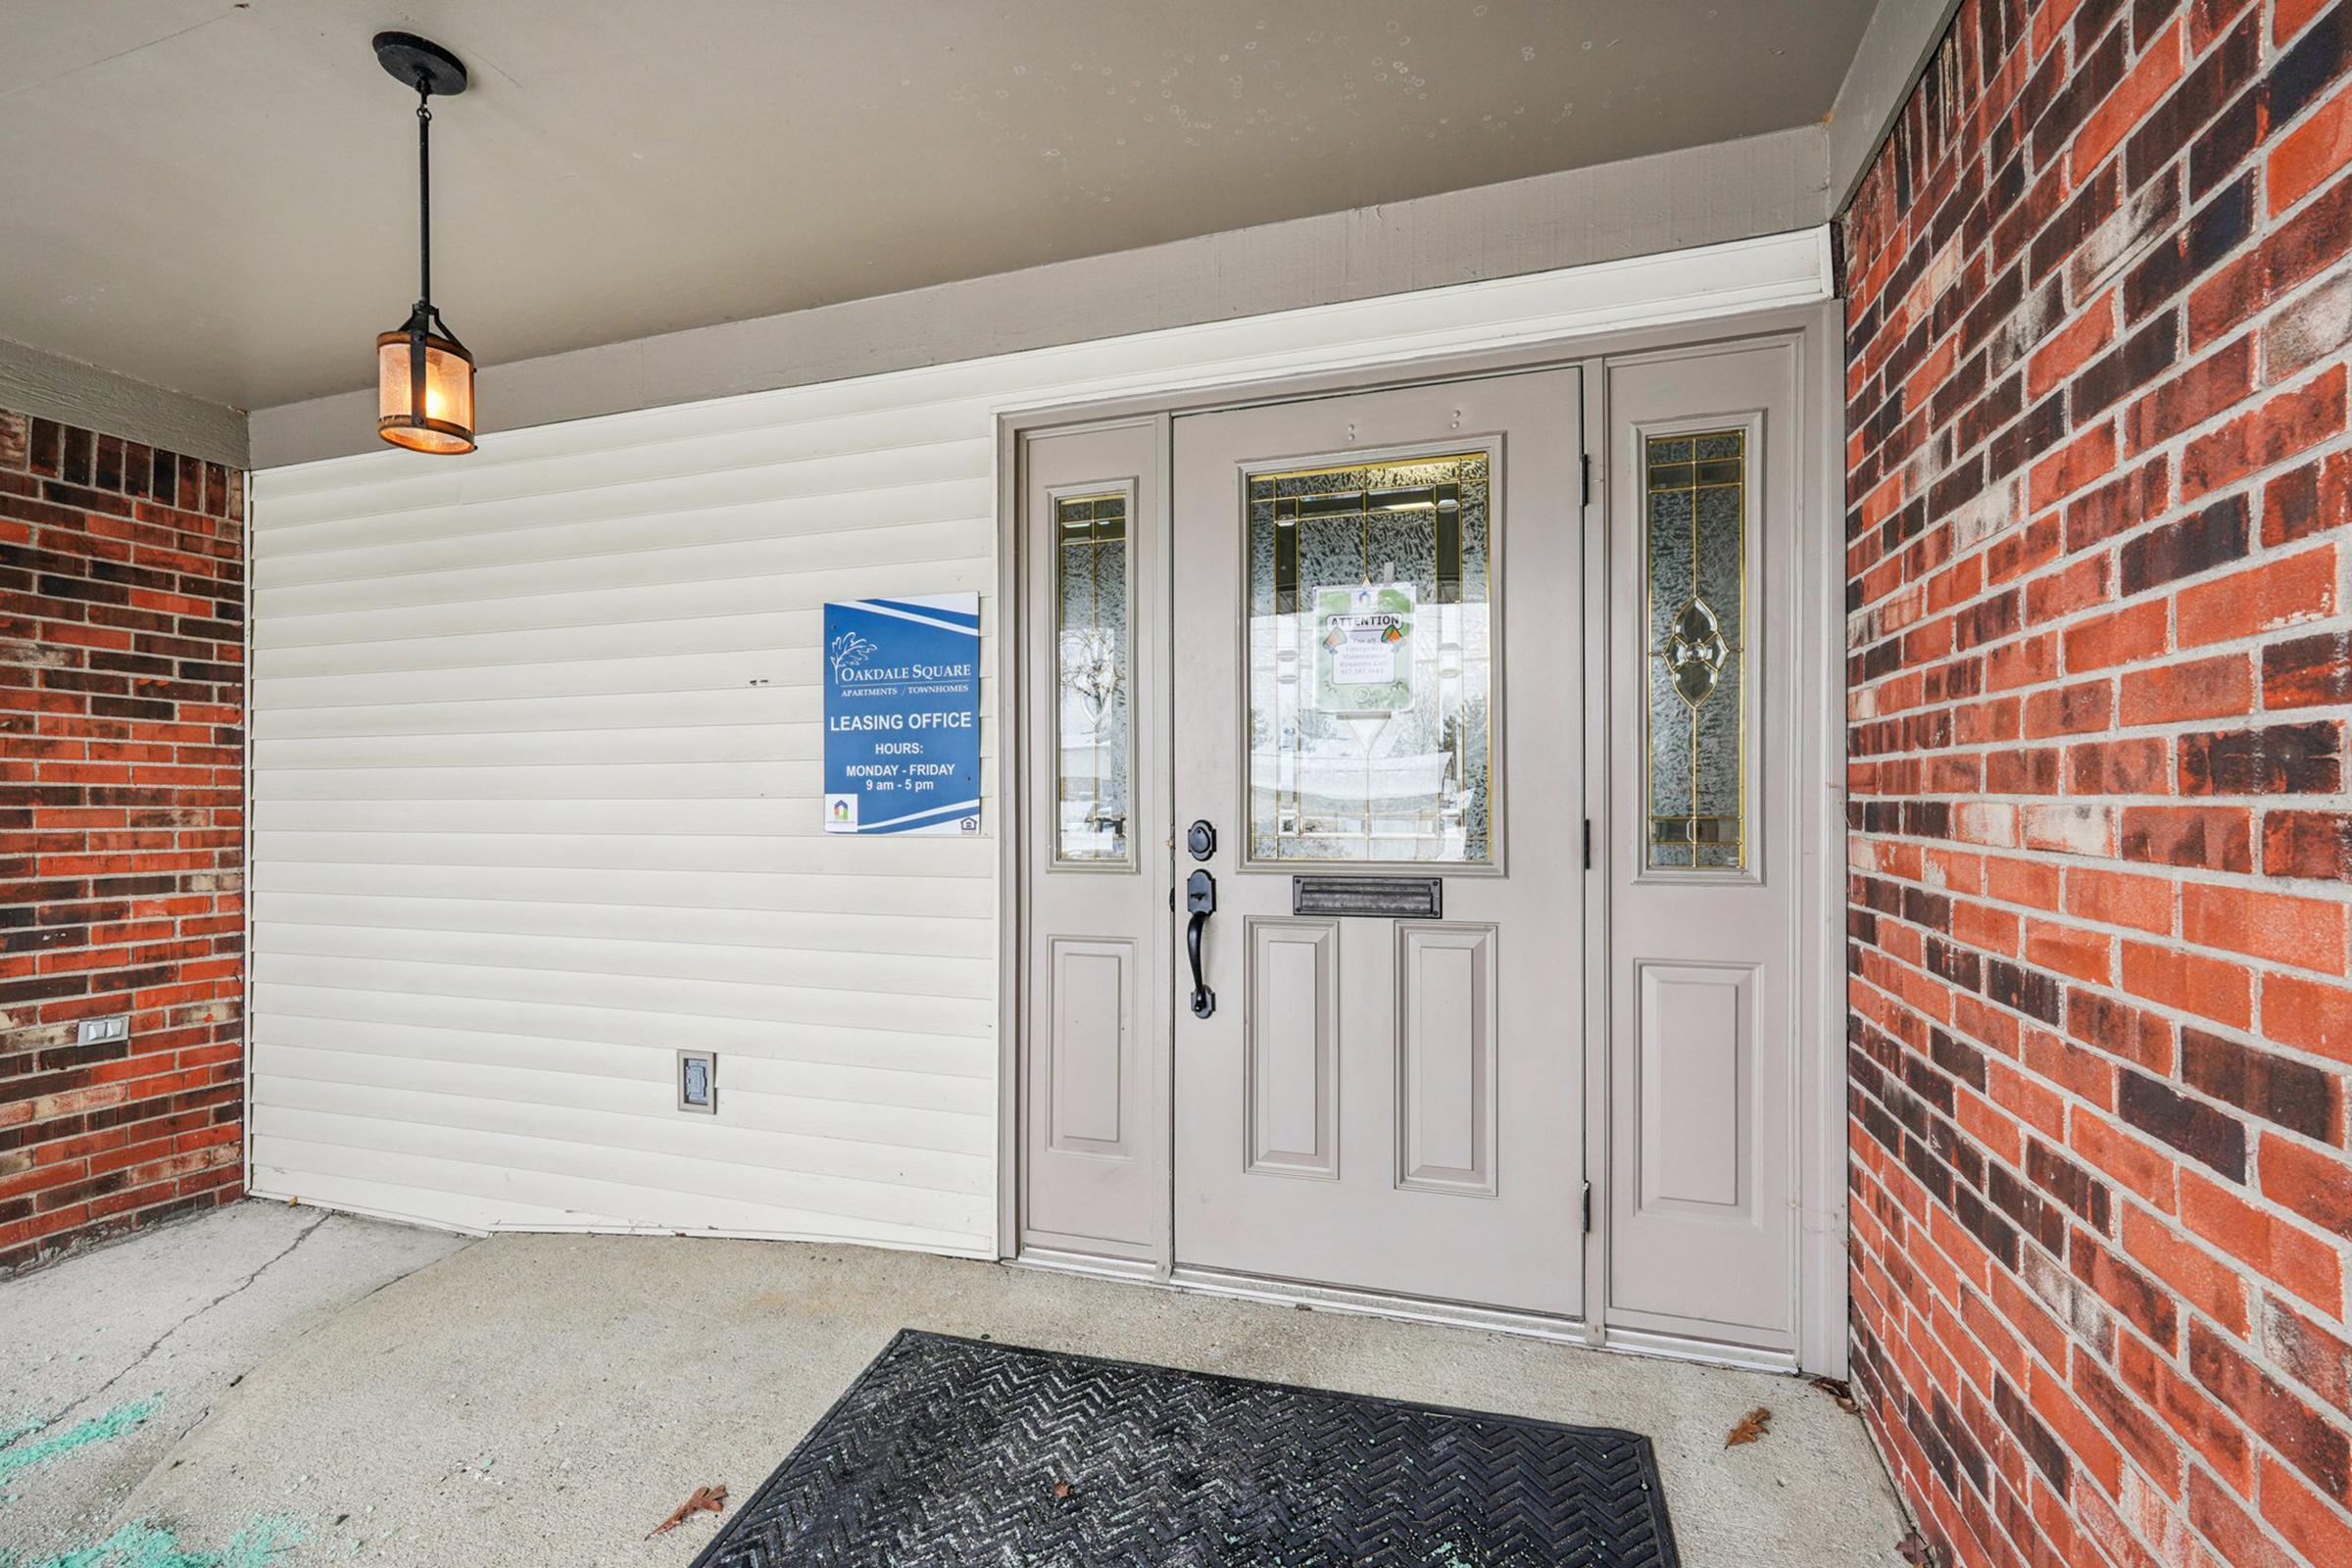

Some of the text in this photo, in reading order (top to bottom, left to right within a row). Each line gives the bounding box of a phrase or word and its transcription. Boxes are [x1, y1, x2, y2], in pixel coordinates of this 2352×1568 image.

[1331, 615, 1399, 626] ATTENTION
[841, 663, 971, 682] OAKDALE SQUARE
[841, 687, 898, 698] APARTMENTS
[907, 684, 969, 695] TOWNHOMES
[830, 711, 972, 731] LEASING OFFICE
[875, 742, 924, 755] HOURS:
[846, 764, 899, 777] MONDAY
[909, 763, 956, 775] FRIDAY
[865, 779, 873, 791] 9
[876, 781, 894, 790] am
[905, 778, 912, 790] 5
[915, 780, 934, 792] pm
